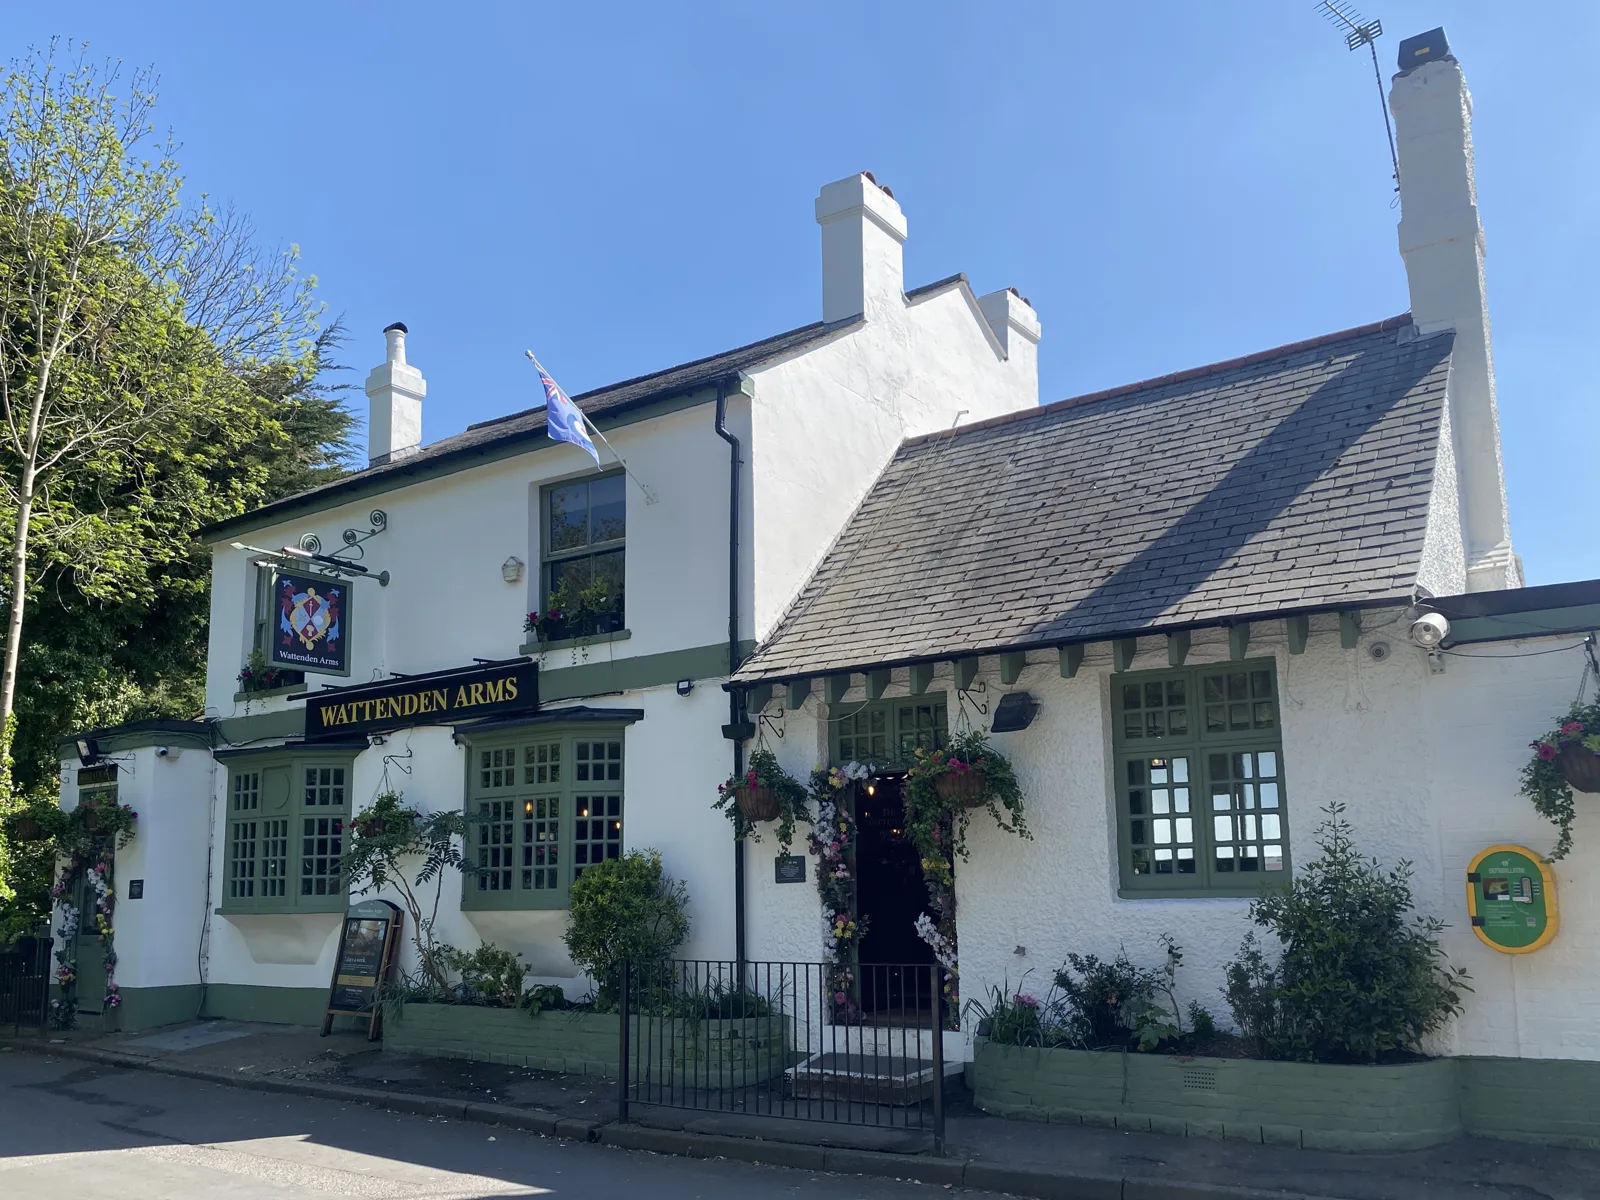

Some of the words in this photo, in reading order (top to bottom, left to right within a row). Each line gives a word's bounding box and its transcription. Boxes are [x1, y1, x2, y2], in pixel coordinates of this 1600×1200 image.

[279, 650, 318, 663] Wattenden
[319, 656, 339, 666] Arms
[320, 687, 449, 727] WATTENDEN
[453, 676, 518, 709] ARMS
